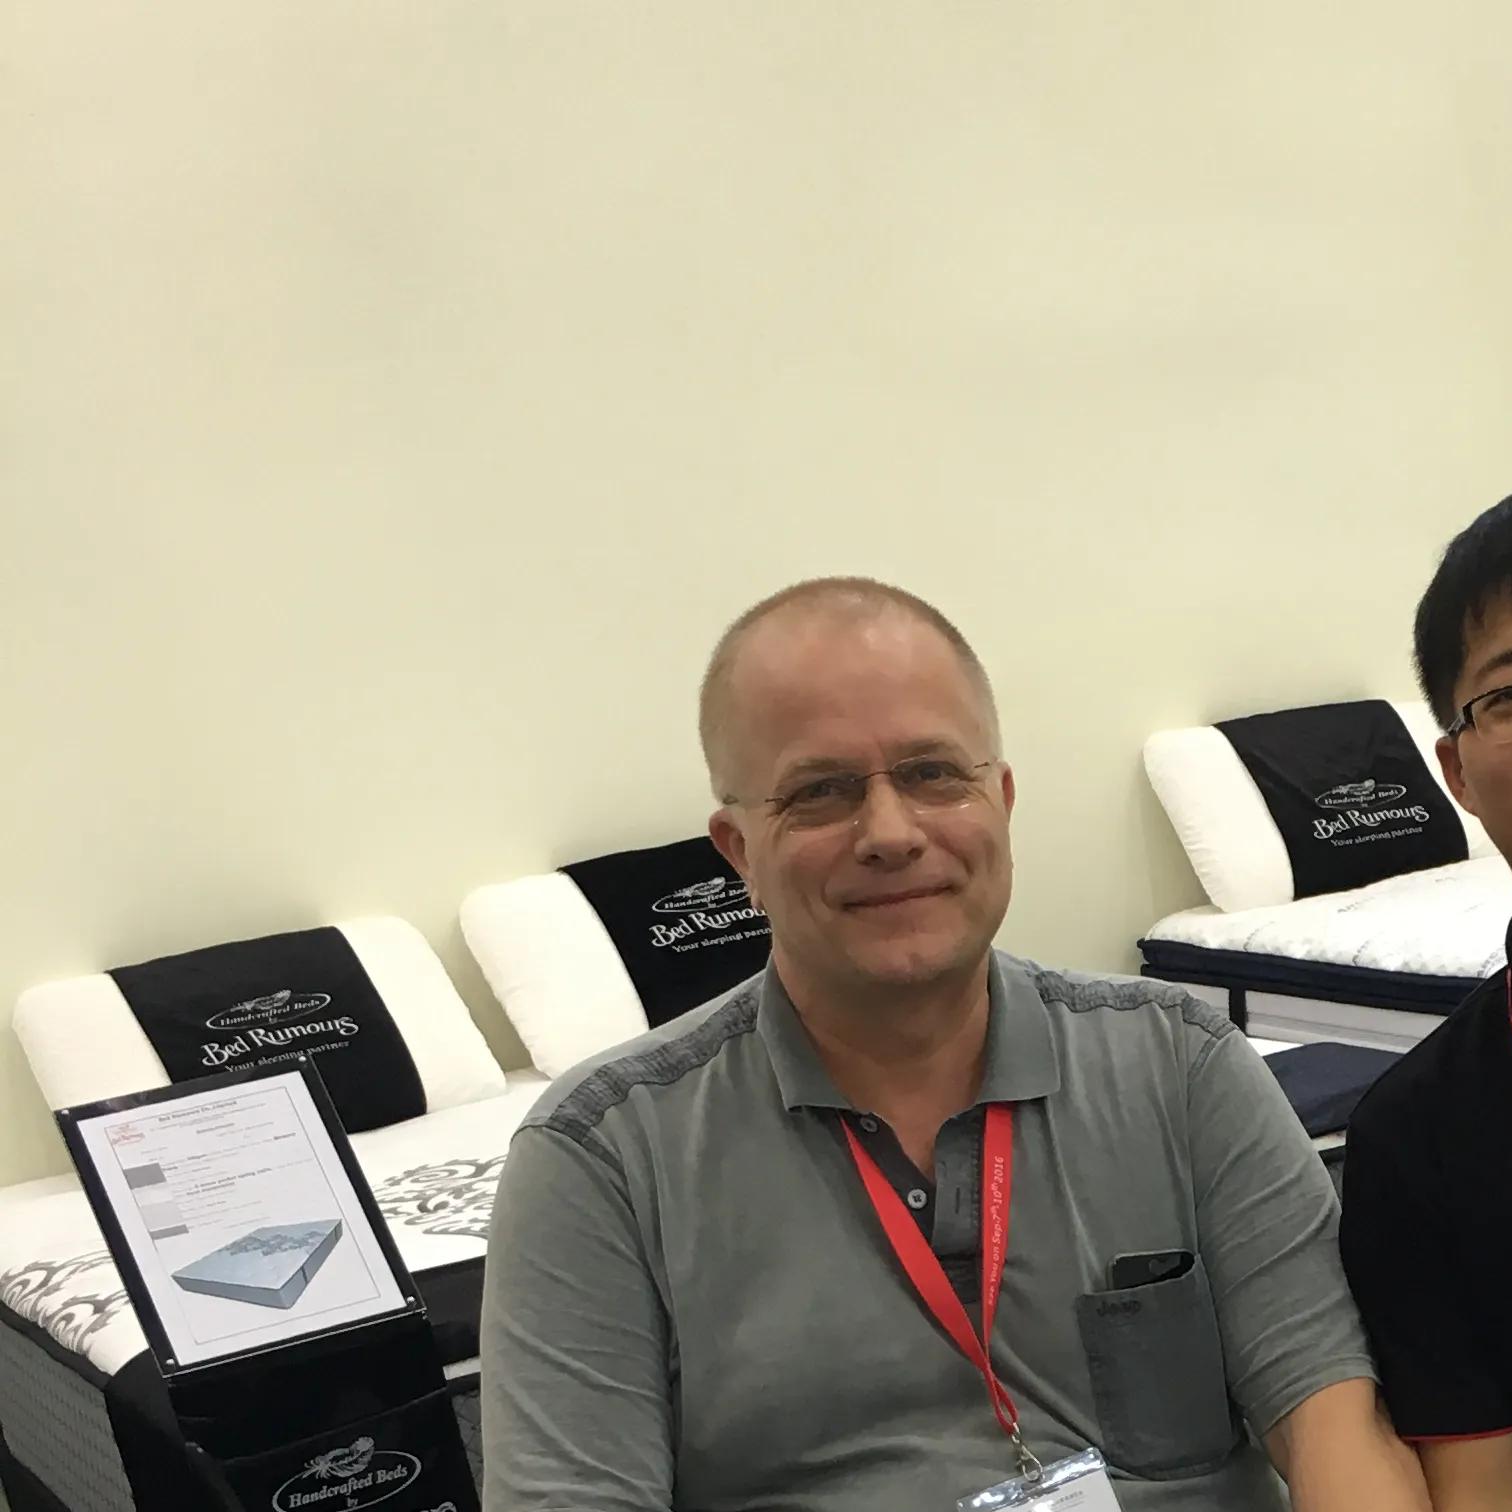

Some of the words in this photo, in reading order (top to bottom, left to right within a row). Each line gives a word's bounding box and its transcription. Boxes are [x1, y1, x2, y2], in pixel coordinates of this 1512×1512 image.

[1312, 813, 1350, 839] Bed
[1347, 805, 1429, 827] Rumours
[1331, 837, 1353, 847] Your
[649, 918, 695, 947] Bed
[688, 908, 767, 931] Rumou
[672, 942, 699, 953] Your
[201, 1035, 251, 1066] Bed
[247, 1016, 360, 1048] Rumours
[288, 1473, 373, 1509] Handcrafted
[376, 1464, 409, 1485] Beds
